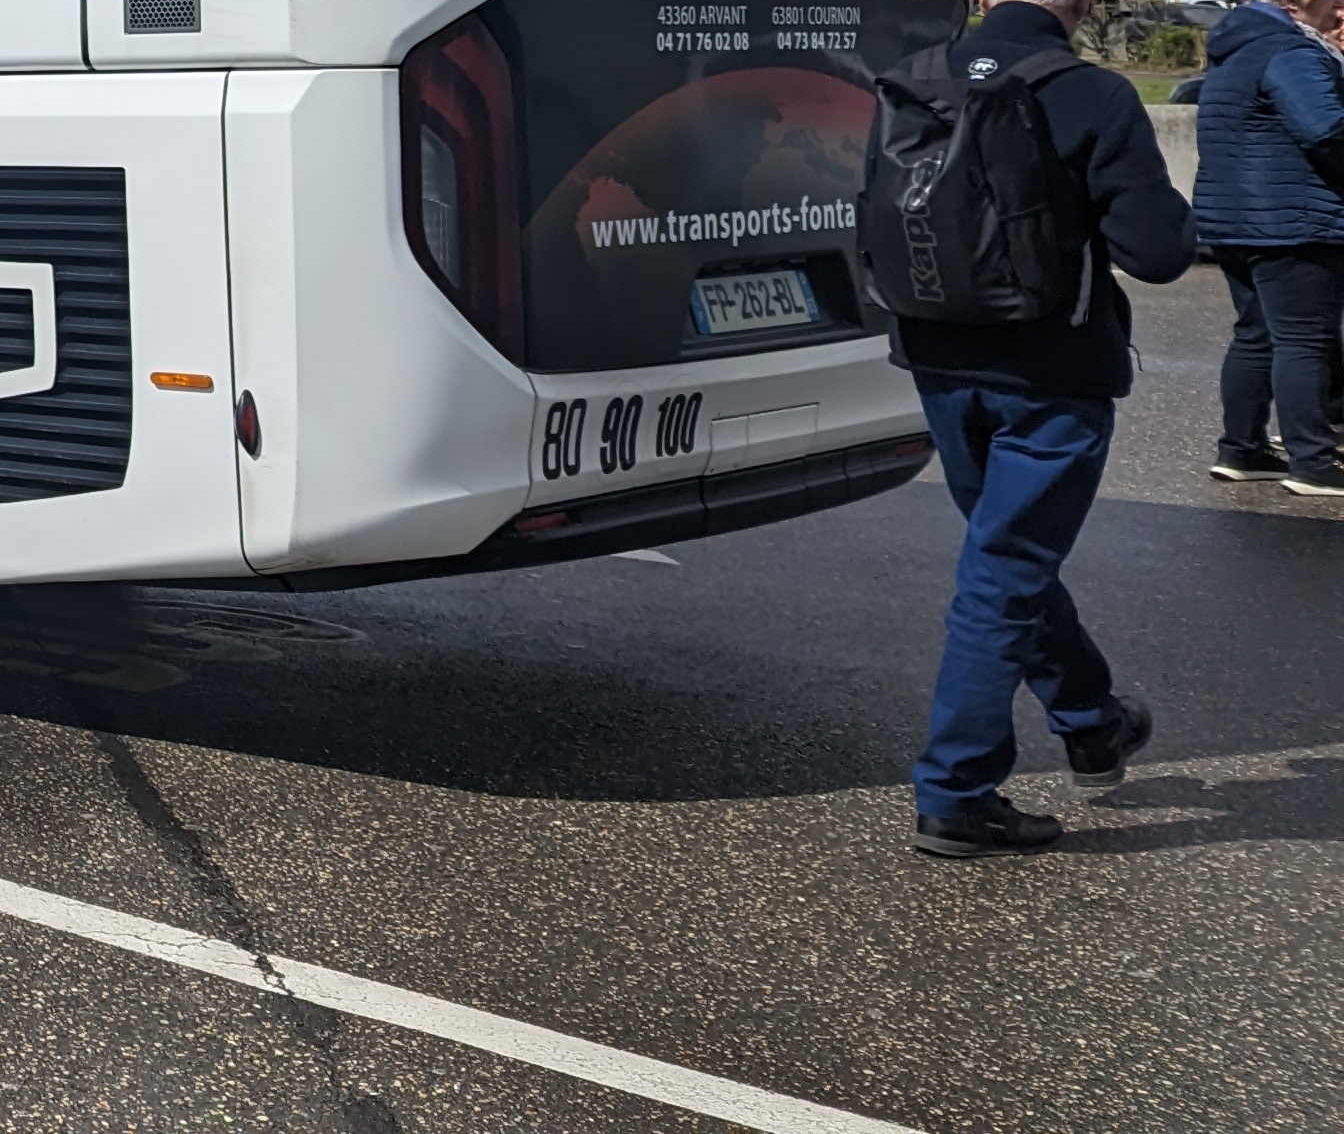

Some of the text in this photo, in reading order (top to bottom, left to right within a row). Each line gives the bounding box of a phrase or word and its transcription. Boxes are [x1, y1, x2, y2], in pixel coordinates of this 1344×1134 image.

[657, 6, 747, 25] 43360 ARVANT
[772, 6, 861, 25] 63801 COURNON
[656, 32, 750, 51] 04 71 76 02 08
[777, 32, 792, 50] 04
[794, 32, 809, 50] 73
[812, 32, 825, 50] 84
[701, 277, 806, 323] FP-262-BL
[542, 392, 703, 480] 80 90 100
